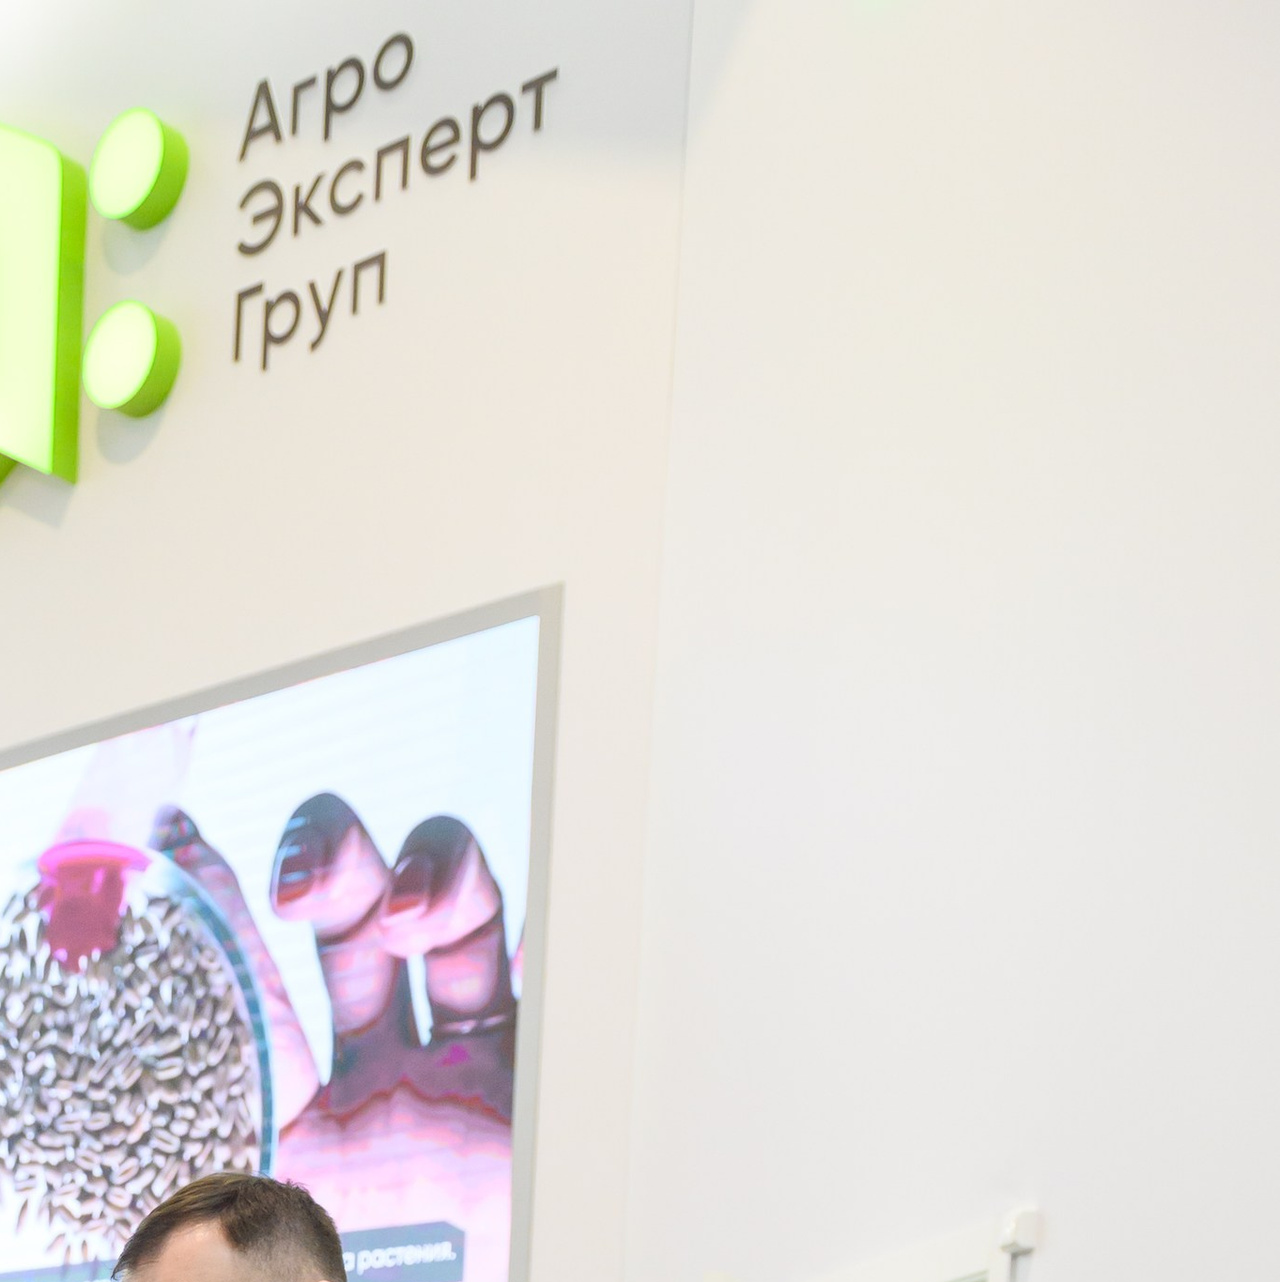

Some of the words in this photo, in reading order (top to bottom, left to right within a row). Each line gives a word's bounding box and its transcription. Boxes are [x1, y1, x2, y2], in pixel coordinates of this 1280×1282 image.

[238, 31, 415, 163] Агро
[237, 67, 559, 257] Эксперт
[233, 250, 387, 371] Груп
[356, 1241, 457, 1276] растения.
